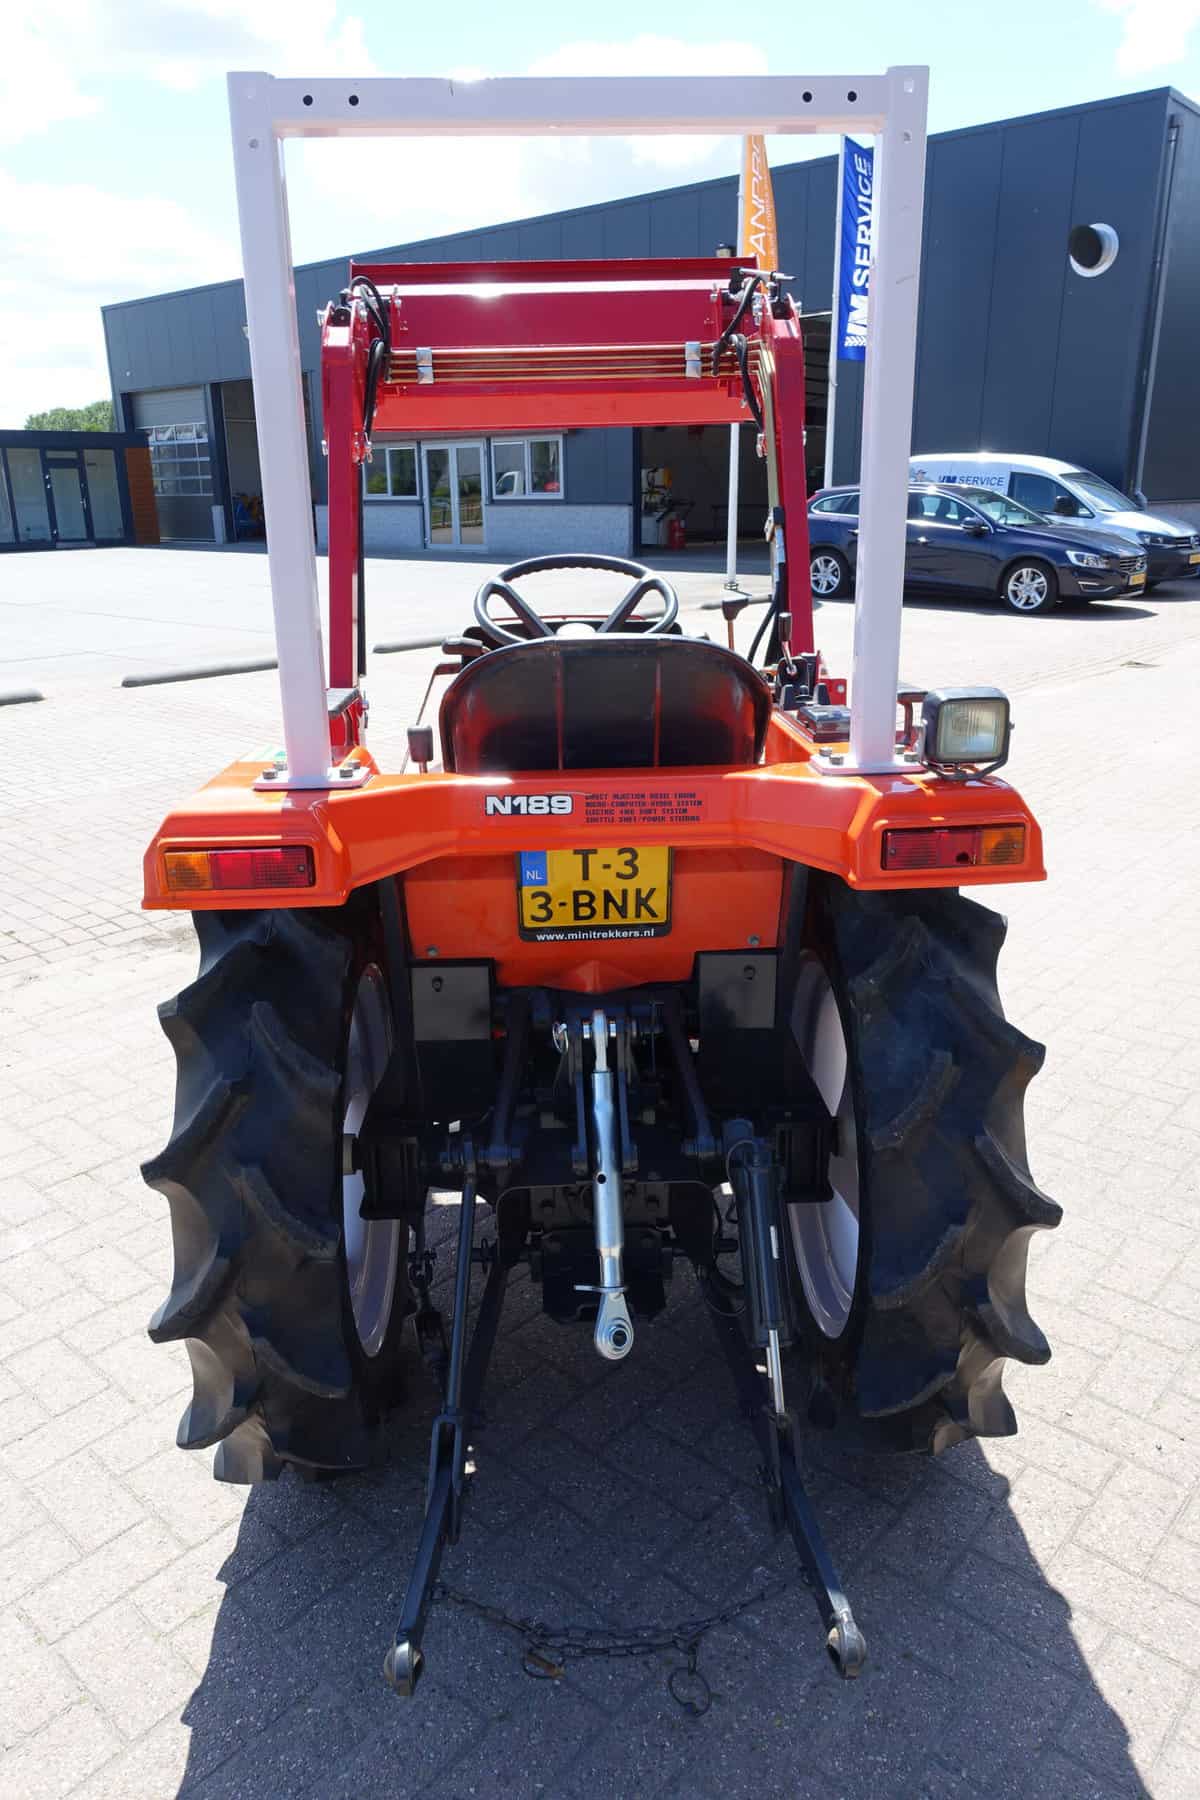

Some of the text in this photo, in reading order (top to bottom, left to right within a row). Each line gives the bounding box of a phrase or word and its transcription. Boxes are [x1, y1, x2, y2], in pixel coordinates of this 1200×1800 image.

[958, 476, 1005, 486] SERVICE
[485, 794, 573, 815] N189
[526, 847, 640, 881] NL T-3
[529, 887, 659, 923] 3-BNK
[535, 928, 655, 942] www.minitrekkers.nl
